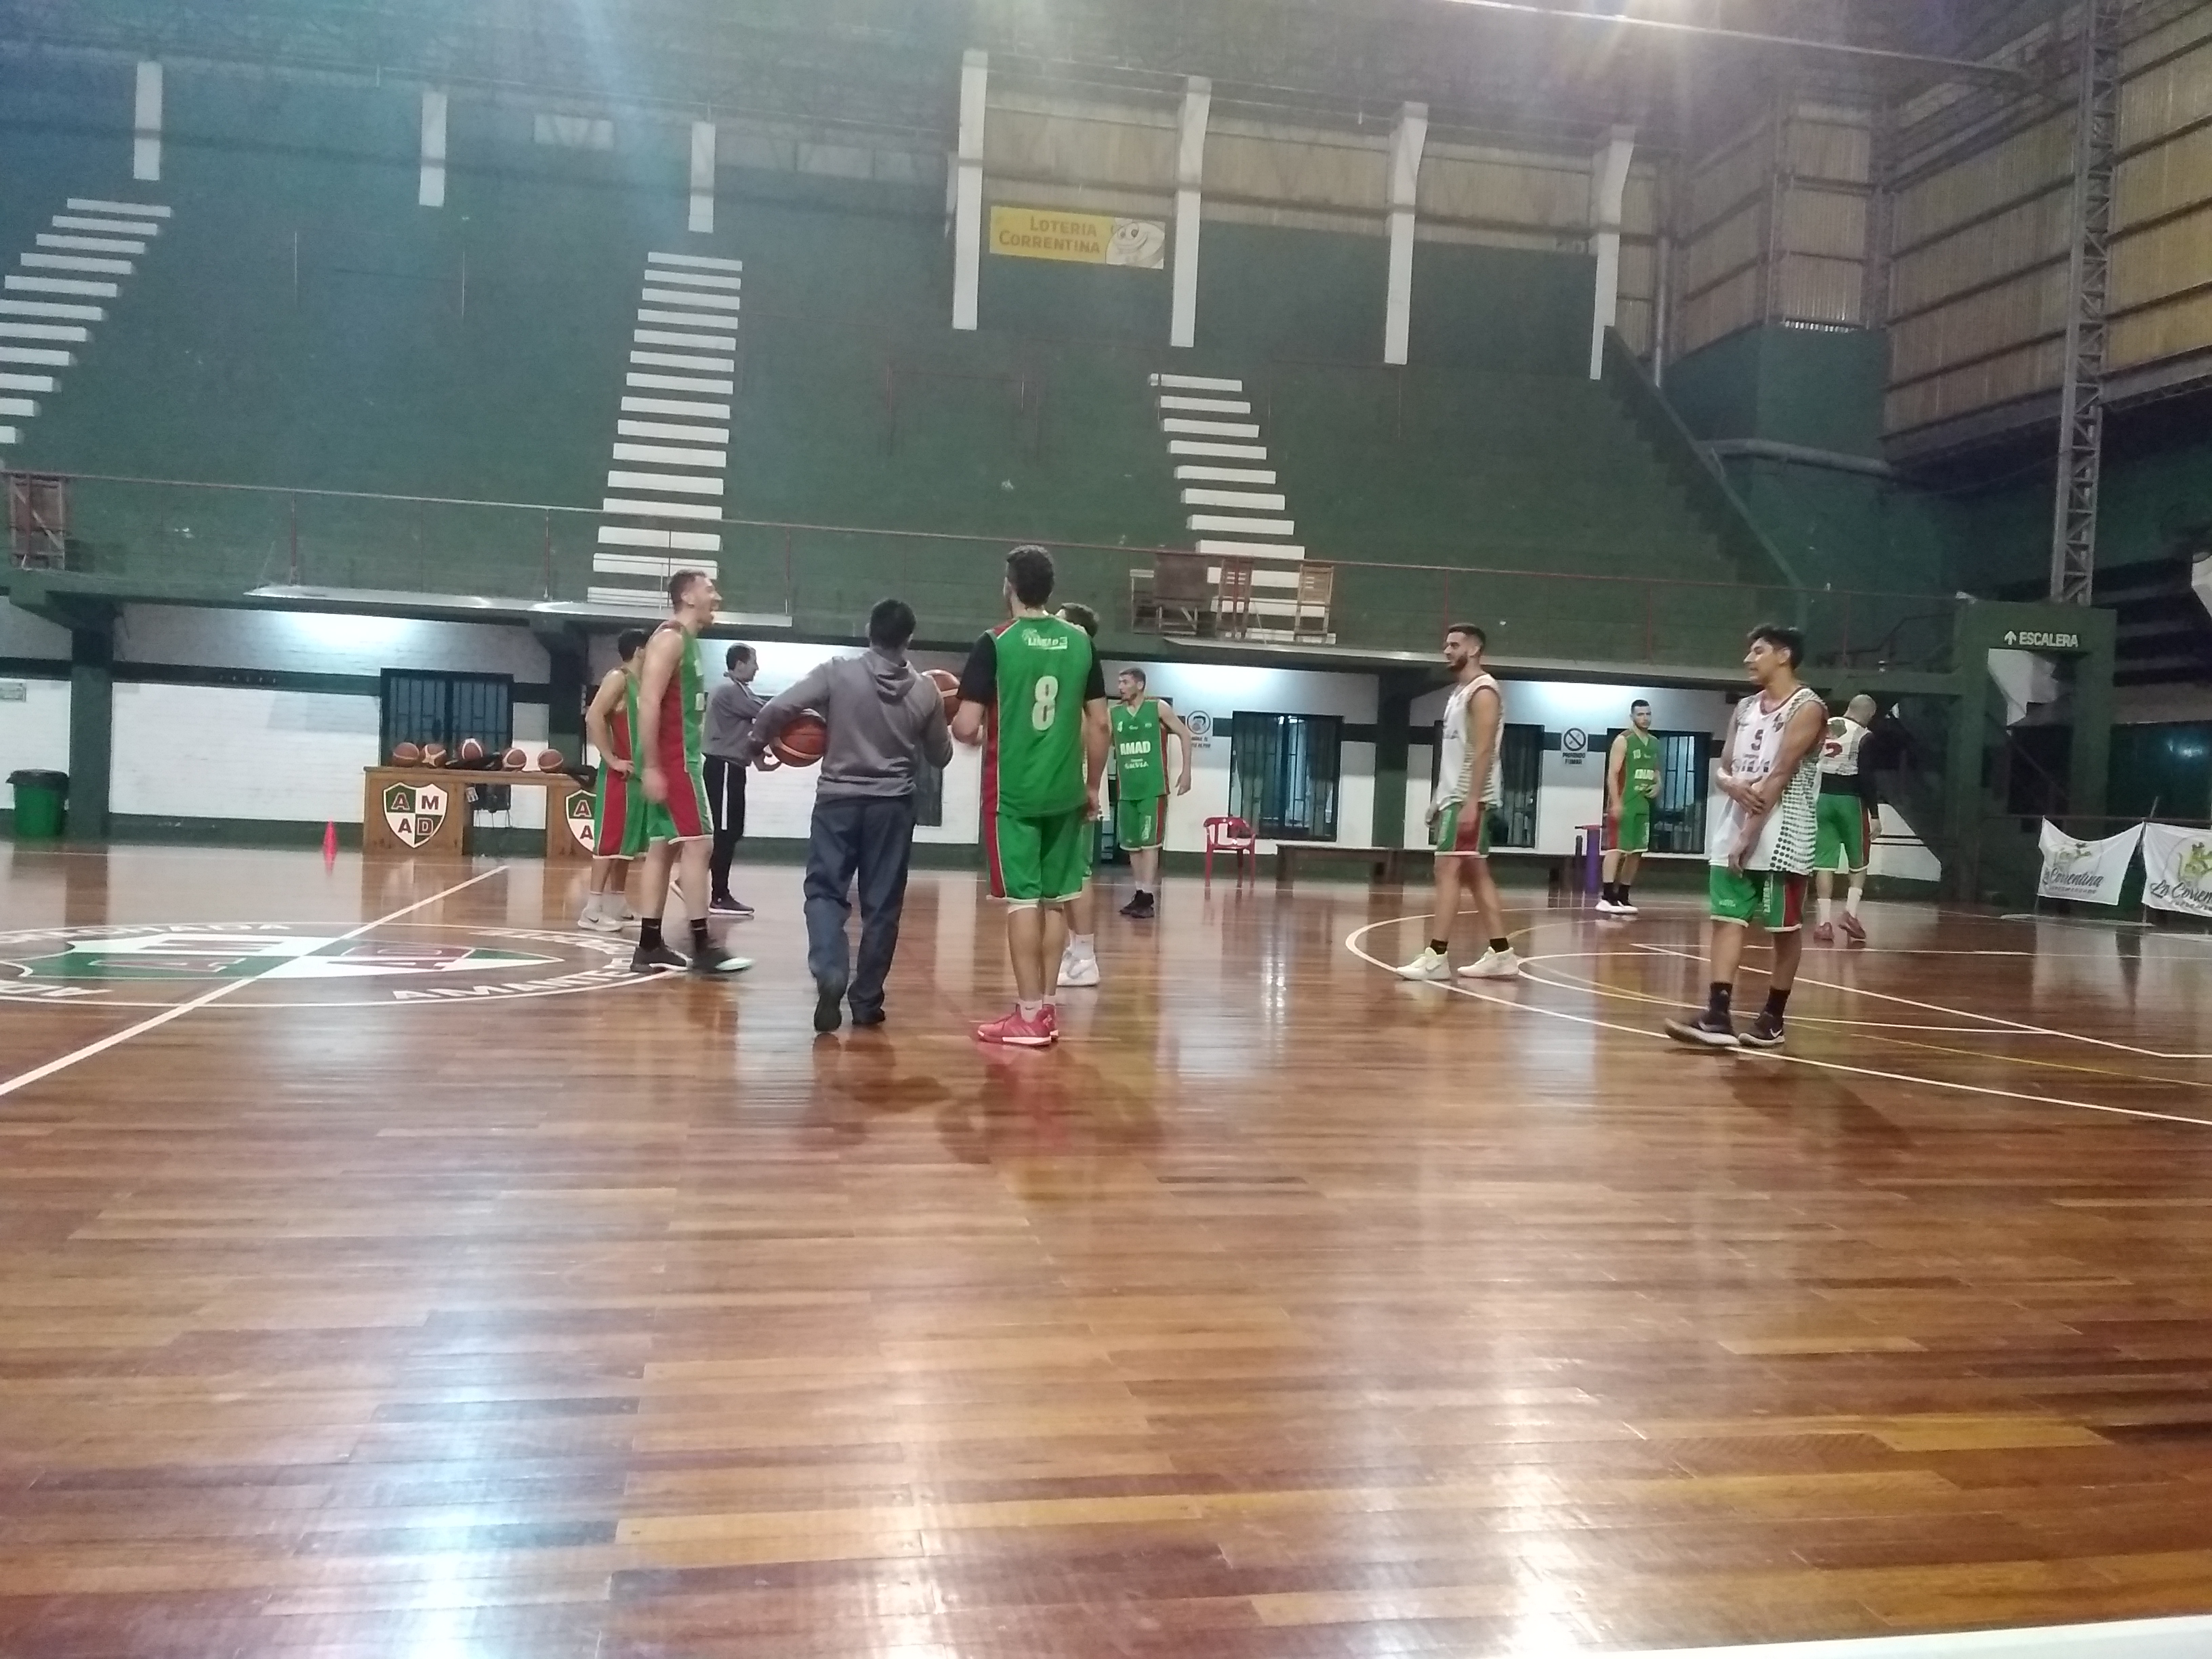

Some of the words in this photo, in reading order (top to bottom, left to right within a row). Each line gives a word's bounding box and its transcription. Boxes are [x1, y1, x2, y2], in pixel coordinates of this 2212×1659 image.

[1030, 216, 1097, 237] LOTERIA
[999, 229, 1100, 253] CORRENTINA
[2019, 632, 2079, 648] ESCALERA
[1032, 675, 1059, 731] 8
[1120, 741, 1151, 756] AMAD
[392, 792, 411, 810] A
[422, 796, 439, 810] M
[573, 800, 592, 817] A
[398, 818, 413, 834] A
[418, 818, 434, 836] D
[580, 825, 594, 840] A
